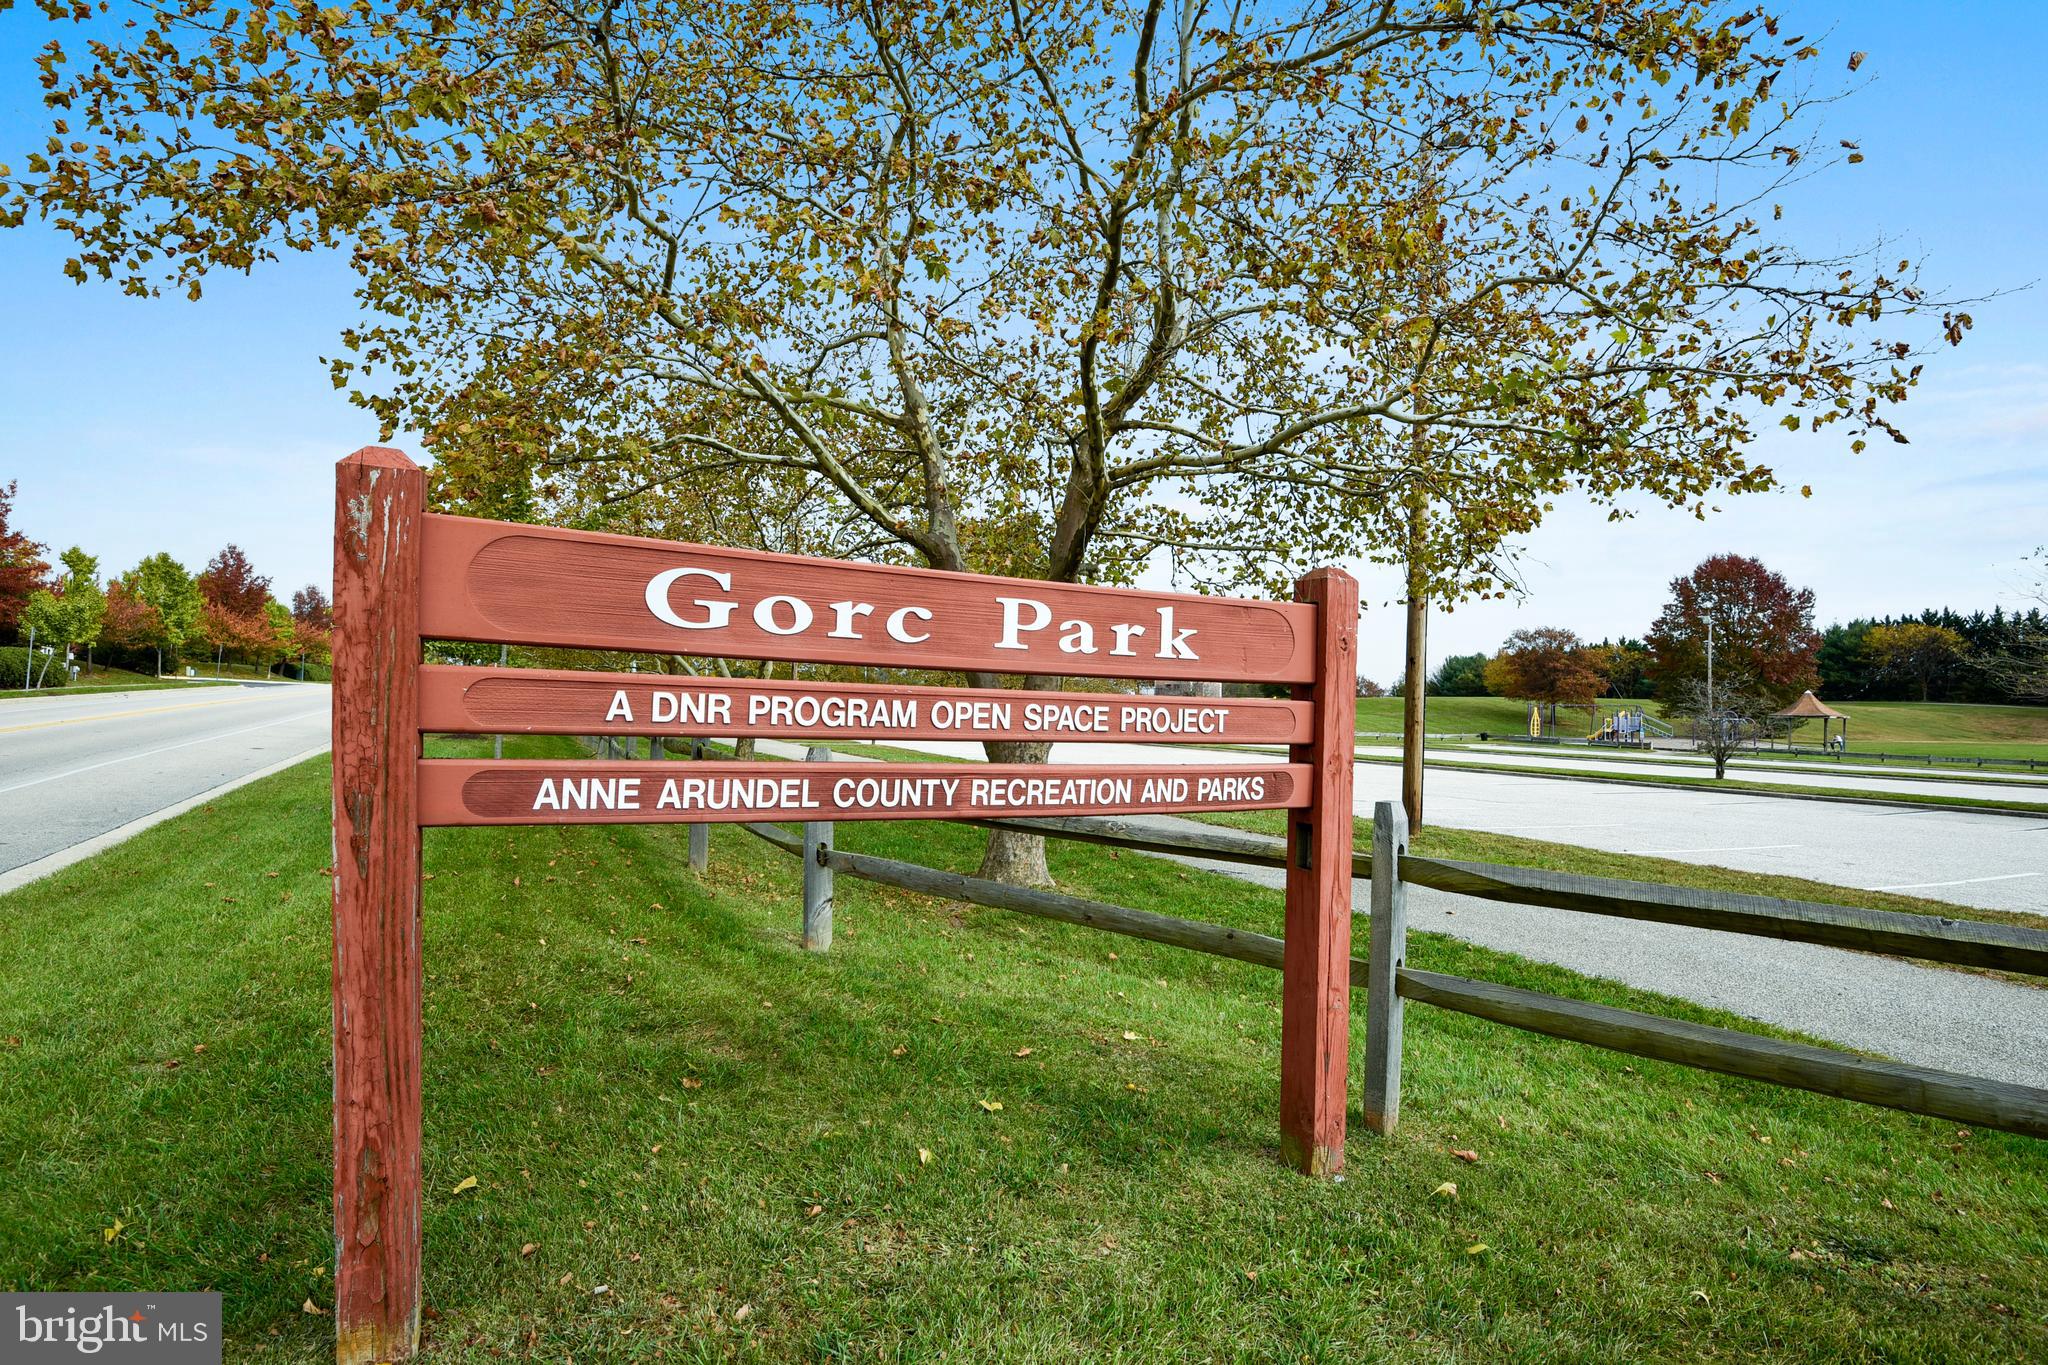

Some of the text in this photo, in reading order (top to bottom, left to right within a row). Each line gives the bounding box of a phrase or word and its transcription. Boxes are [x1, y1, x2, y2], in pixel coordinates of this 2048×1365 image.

[645, 567, 1201, 661] Gorc Park
[605, 689, 1232, 736] A DNR PROGRAM OPEN SPACE PROJECT
[532, 776, 1265, 811] ANNE ARUNDEL COUNTY RECREATION AND PARKS
